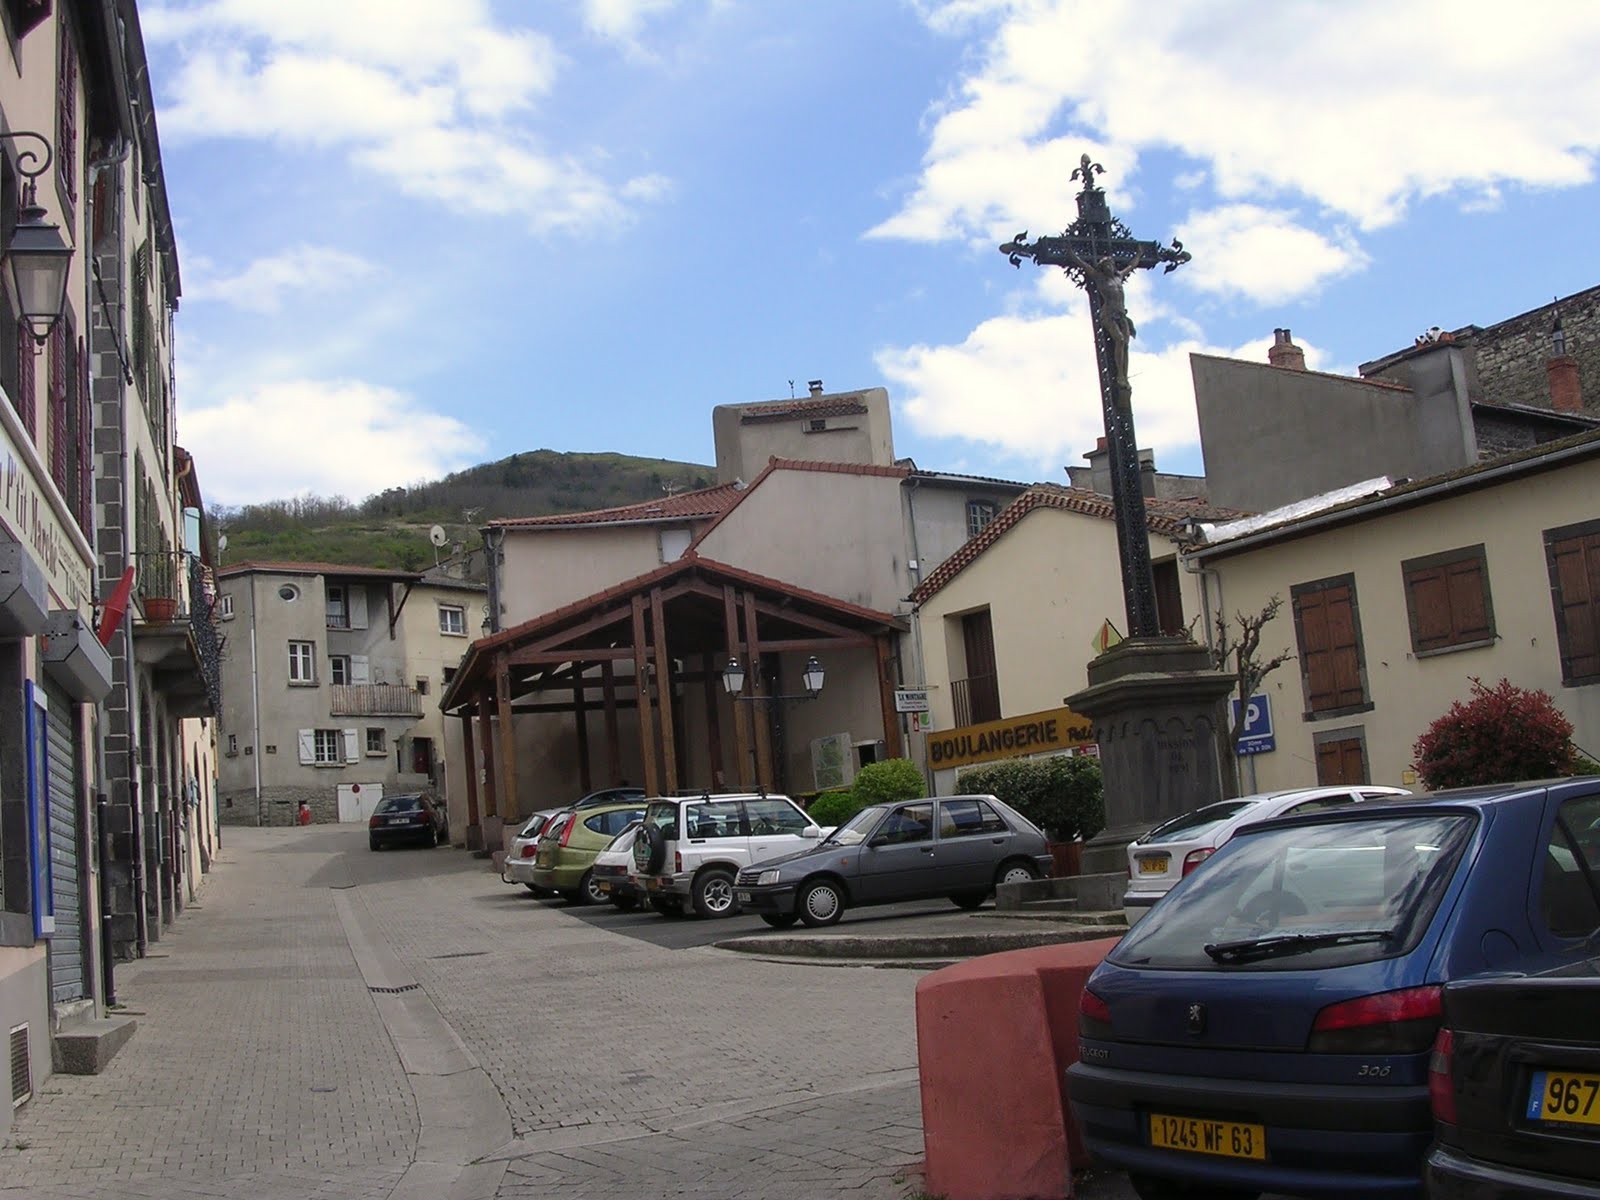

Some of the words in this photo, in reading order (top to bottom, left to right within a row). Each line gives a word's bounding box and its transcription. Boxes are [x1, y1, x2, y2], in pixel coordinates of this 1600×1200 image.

[1244, 703, 1260, 731] P
[930, 719, 1058, 763] BOULANGERIE
[1358, 1065, 1391, 1077] 306
[1532, 1101, 1539, 1112] F
[1547, 1077, 1600, 1116] 967
[1161, 1117, 1198, 1149] 1245
[1203, 1122, 1224, 1152] WF
[1231, 1126, 1253, 1155] 63
